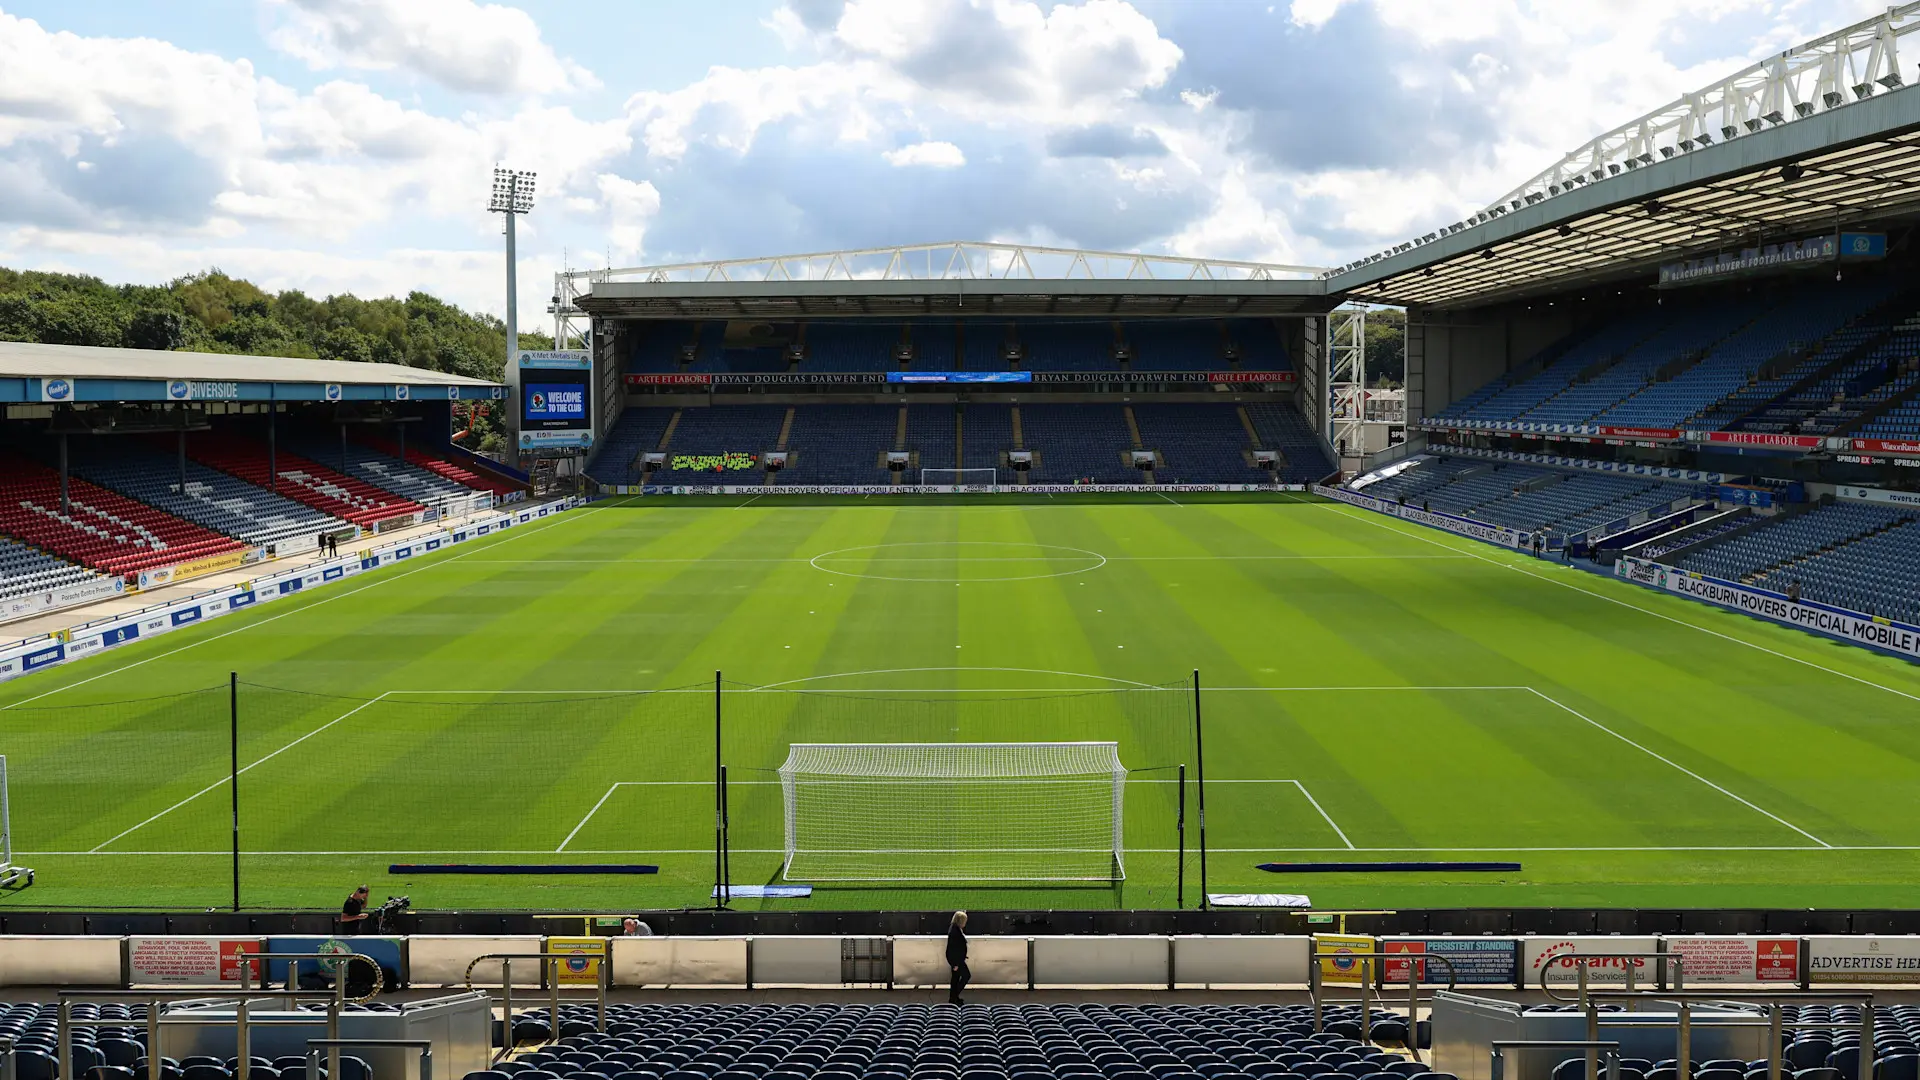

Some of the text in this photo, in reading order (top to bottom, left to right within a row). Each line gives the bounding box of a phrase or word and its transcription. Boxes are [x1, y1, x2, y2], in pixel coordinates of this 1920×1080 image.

[1671, 247, 1818, 281] BLACKBURN ROVERS FOOTBALL CLUB
[638, 375, 708, 383] ARTE ET LABORE
[715, 375, 885, 383] BRYAN DOUGLAS DARWEN END
[1034, 373, 1205, 382] BRYAN DOUGLAS DARWEN END
[1212, 373, 1282, 381] ARTE ET LABORE
[191, 382, 238, 398] RIVERSIDE
[548, 391, 582, 403] WELCOME
[548, 404, 556, 412] TO
[556, 404, 567, 412] THE
[567, 404, 582, 412] CLUB
[1727, 433, 1799, 446] ARTE ET LABORE
[1854, 440, 1865, 449] WR
[1837, 455, 1860, 463] SPREAD
[1861, 456, 1870, 464] EX
[1893, 458, 1920, 467] SPREAD
[735, 486, 786, 494] BLACKBURN
[788, 486, 821, 494] ROVERS
[1405, 509, 1429, 521] BLACKBURN
[1429, 514, 1446, 527] ROVERS
[1446, 518, 1466, 532] OFFICIAL
[1467, 524, 1485, 538] MOBILE
[1485, 529, 1513, 545] NETWORK
[1634, 561, 1655, 576] ROVERS
[1631, 569, 1655, 583] CONNECT
[61, 585, 113, 601] Porsche Centre Preston
[1678, 577, 1911, 651] BLACKBURN ROVERS OFFICIAL MOBILE
[70, 645, 81, 653] WHEN
[2, 664, 12, 672] PARK
[1427, 941, 1515, 951] PERSISTENT STANDING
[1810, 957, 1893, 969] ADVERTISE
